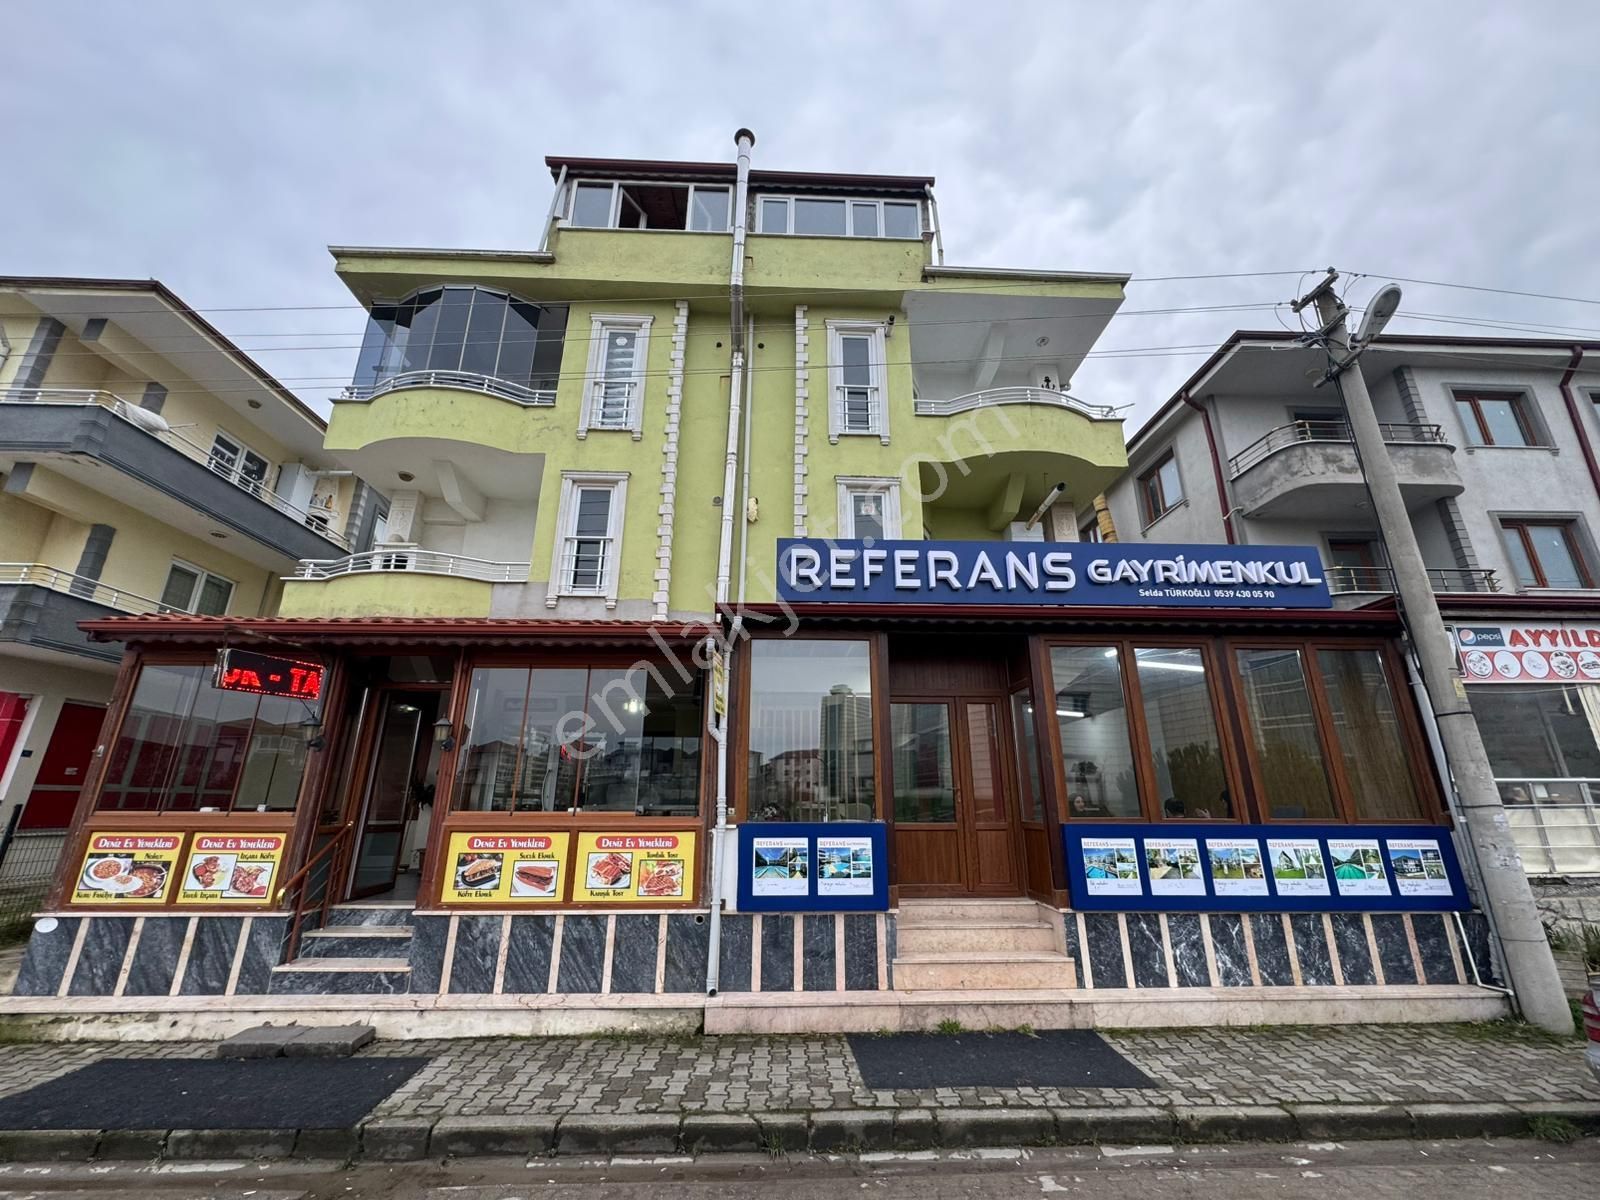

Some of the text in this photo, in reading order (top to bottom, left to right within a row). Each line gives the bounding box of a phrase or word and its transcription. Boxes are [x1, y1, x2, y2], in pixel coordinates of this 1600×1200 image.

[789, 548, 1322, 591] REFERANS GAYRİMENKUL
[1138, 588, 1275, 599] Selda TÜRKOĞLU 0539 430 05 90
[1476, 632, 1502, 641] pepsi
